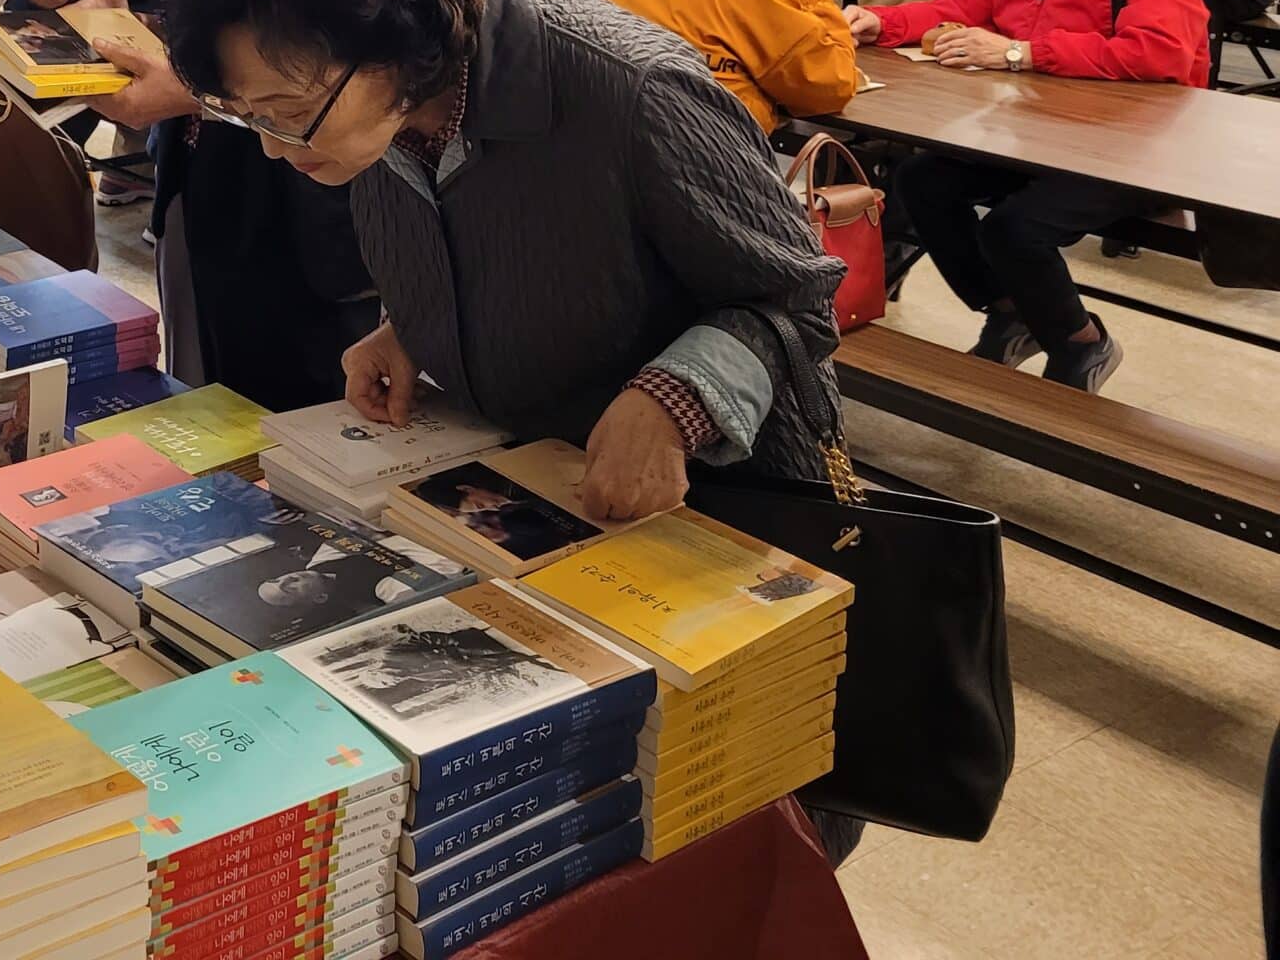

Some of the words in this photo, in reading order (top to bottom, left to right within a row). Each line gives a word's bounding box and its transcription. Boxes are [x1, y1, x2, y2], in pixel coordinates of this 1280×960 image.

[618, 583, 678, 614] 치유의
[179, 728, 222, 763] 이런
[208, 720, 256, 753] 일이
[441, 752, 474, 777] 토머스
[480, 736, 517, 763] 머튼의
[523, 721, 552, 744] 시간
[110, 743, 170, 792] 어떻게
[140, 732, 201, 783] 나에게
[435, 787, 467, 812] 토머스
[473, 771, 509, 796] 머튼의
[515, 756, 543, 777] 시간
[223, 826, 255, 847] 나에게
[278, 810, 298, 825] 일이
[435, 831, 466, 856] 토머스
[471, 813, 504, 839] 머튼의
[511, 796, 539, 818] 시간
[217, 864, 248, 886] 나에게
[273, 847, 293, 863] 일이
[220, 846, 251, 868] 나에게
[275, 831, 296, 846] 일이
[216, 886, 247, 907] 나에게
[270, 869, 290, 885] 일이
[438, 876, 469, 903] 토머스
[475, 858, 509, 884] 머튼의
[515, 841, 543, 863] 시간
[218, 907, 248, 928] 나에게
[271, 887, 290, 903] 일이
[443, 922, 474, 948] 토머스
[480, 901, 514, 929] 머튼의
[520, 883, 547, 905] 시간
[215, 926, 245, 948] 나에게
[268, 908, 288, 924] 일이
[266, 927, 286, 943] 일이
